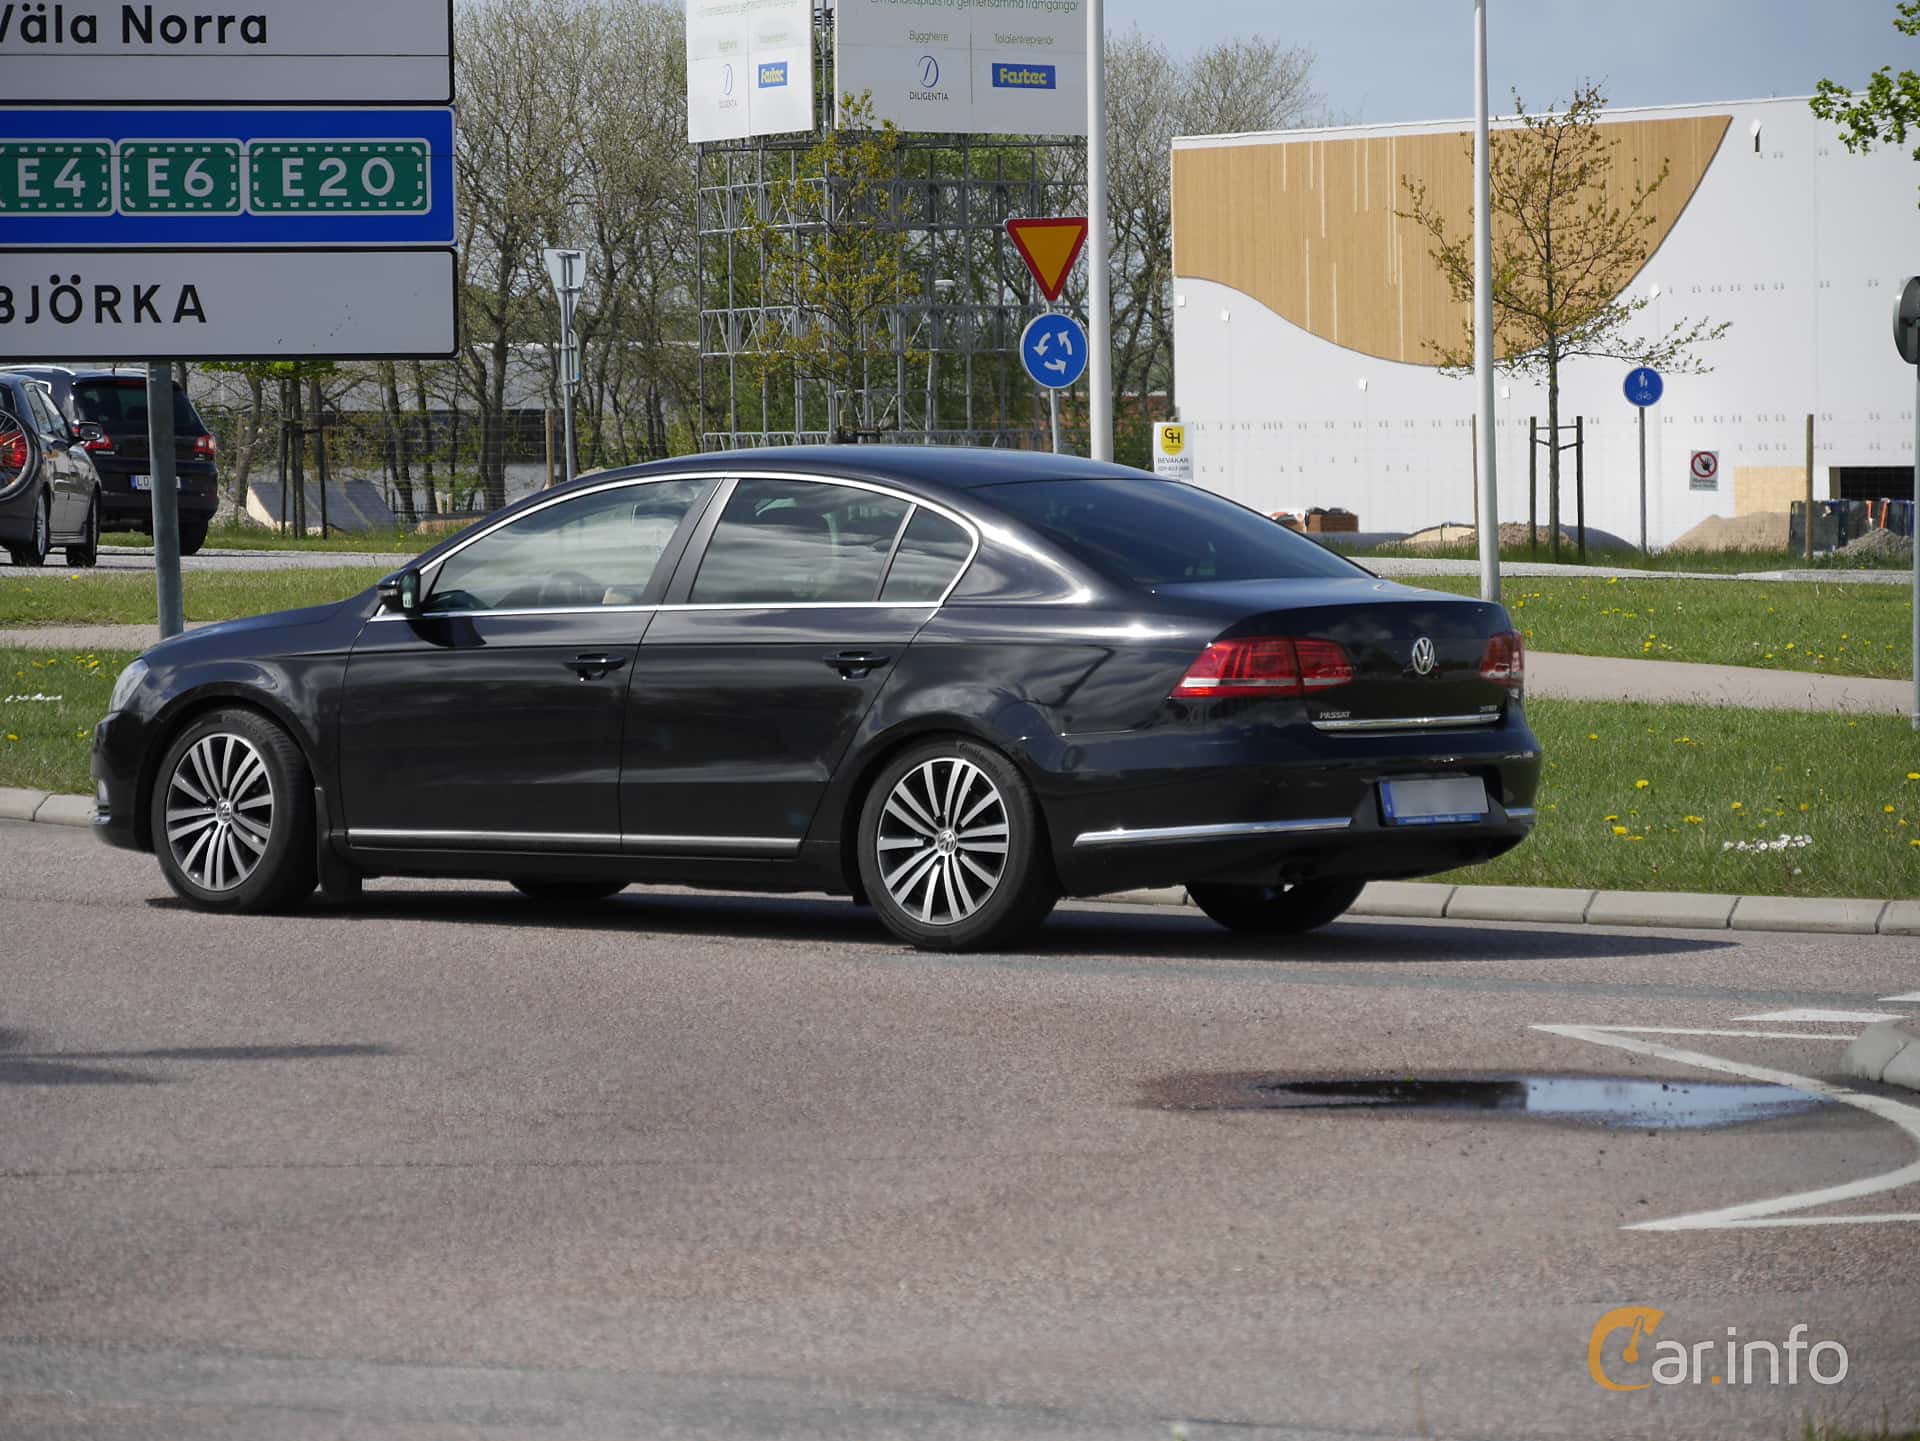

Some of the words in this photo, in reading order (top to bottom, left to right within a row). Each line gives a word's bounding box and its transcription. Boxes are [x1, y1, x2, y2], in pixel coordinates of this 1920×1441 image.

[122, 4, 268, 44] Norra
[909, 91, 949, 101] DILIGENTIA
[281, 157, 396, 197] E20
